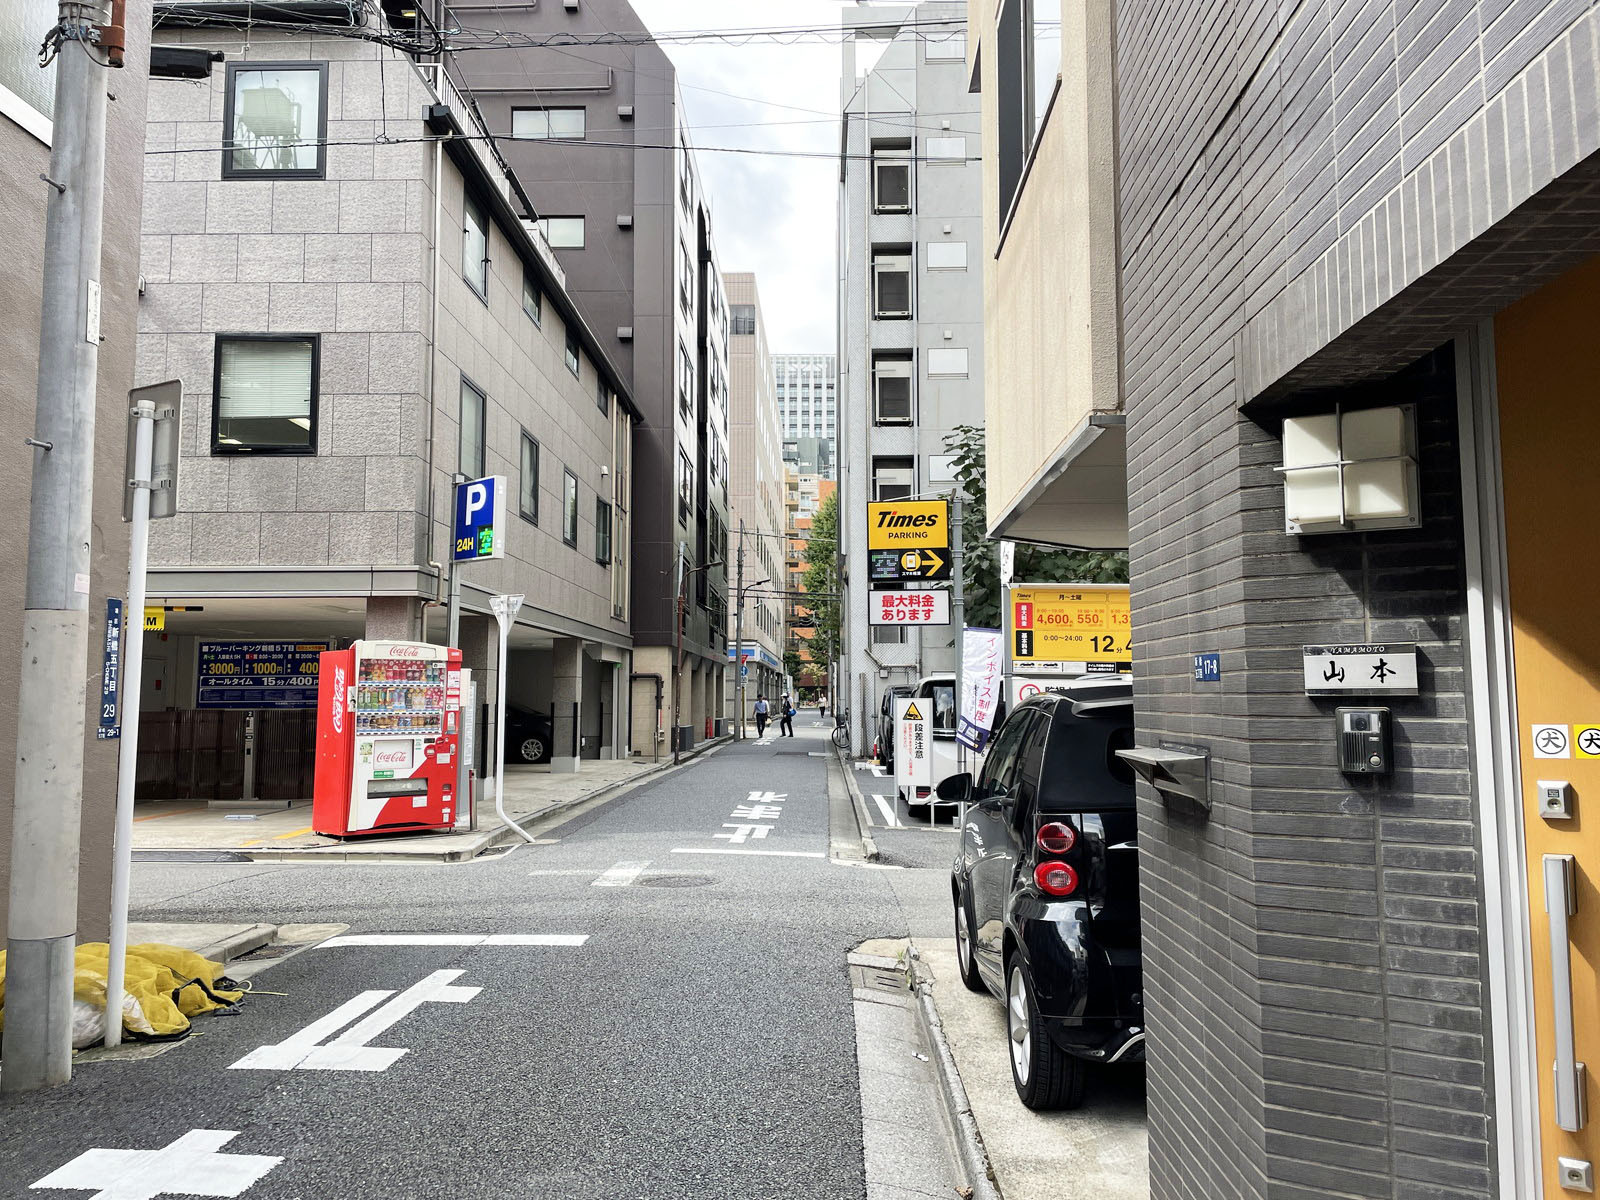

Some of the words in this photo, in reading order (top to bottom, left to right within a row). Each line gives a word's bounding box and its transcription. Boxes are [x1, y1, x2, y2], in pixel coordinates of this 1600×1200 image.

[465, 483, 487, 526] P
[877, 511, 939, 528] Times
[888, 531, 928, 539] PARKING
[456, 537, 474, 552] 24H
[881, 594, 935, 608] 最大料金
[881, 608, 935, 621] あります
[389, 646, 420, 657] Coca-Cola
[1331, 646, 1385, 654] YAMAMOTO
[208, 662, 240, 675] 3000円
[252, 662, 283, 674] 1000円
[1204, 659, 1218, 675] 17-8
[1323, 658, 1397, 684] 山本
[208, 678, 254, 686] オールタイム
[974, 637, 998, 723] インボイス制度
[332, 665, 345, 733] Coca-Cola
[103, 704, 115, 718] 29
[107, 728, 119, 737] 29-1
[1541, 731, 1562, 749] 犬
[914, 723, 924, 759] 段差注意
[1584, 732, 1600, 749] 犬
[376, 751, 407, 763] Coca-Cola
[712, 791, 788, 844] 止まれ
